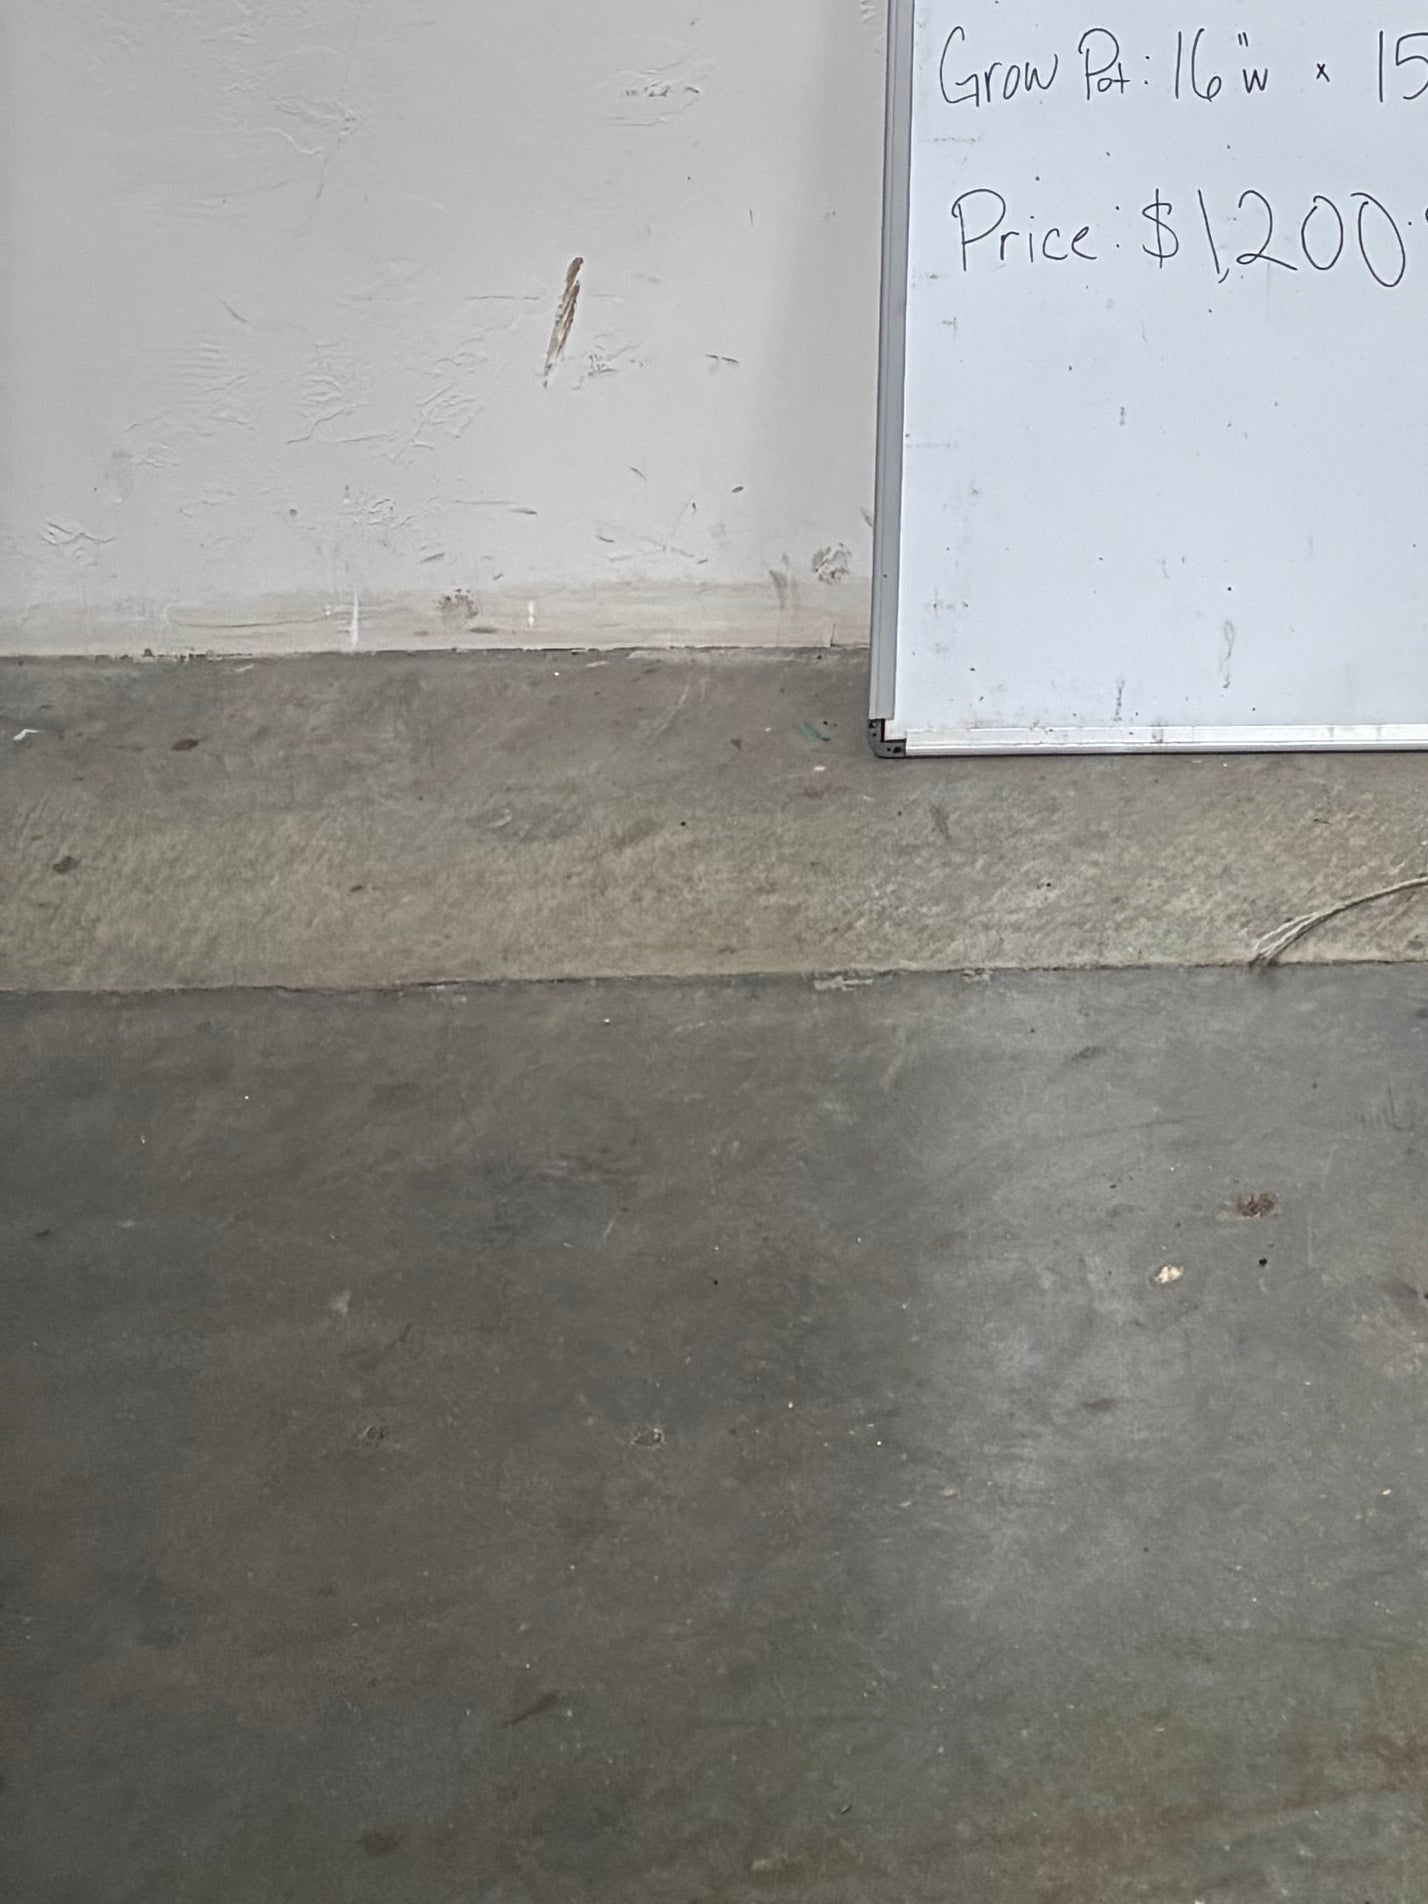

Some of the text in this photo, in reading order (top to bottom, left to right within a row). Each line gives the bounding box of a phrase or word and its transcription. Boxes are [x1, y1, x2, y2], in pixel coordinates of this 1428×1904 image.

[939, 26, 1058, 107] Grow
[1078, 28, 1151, 101] Pot:
[951, 188, 1121, 271] Price:
